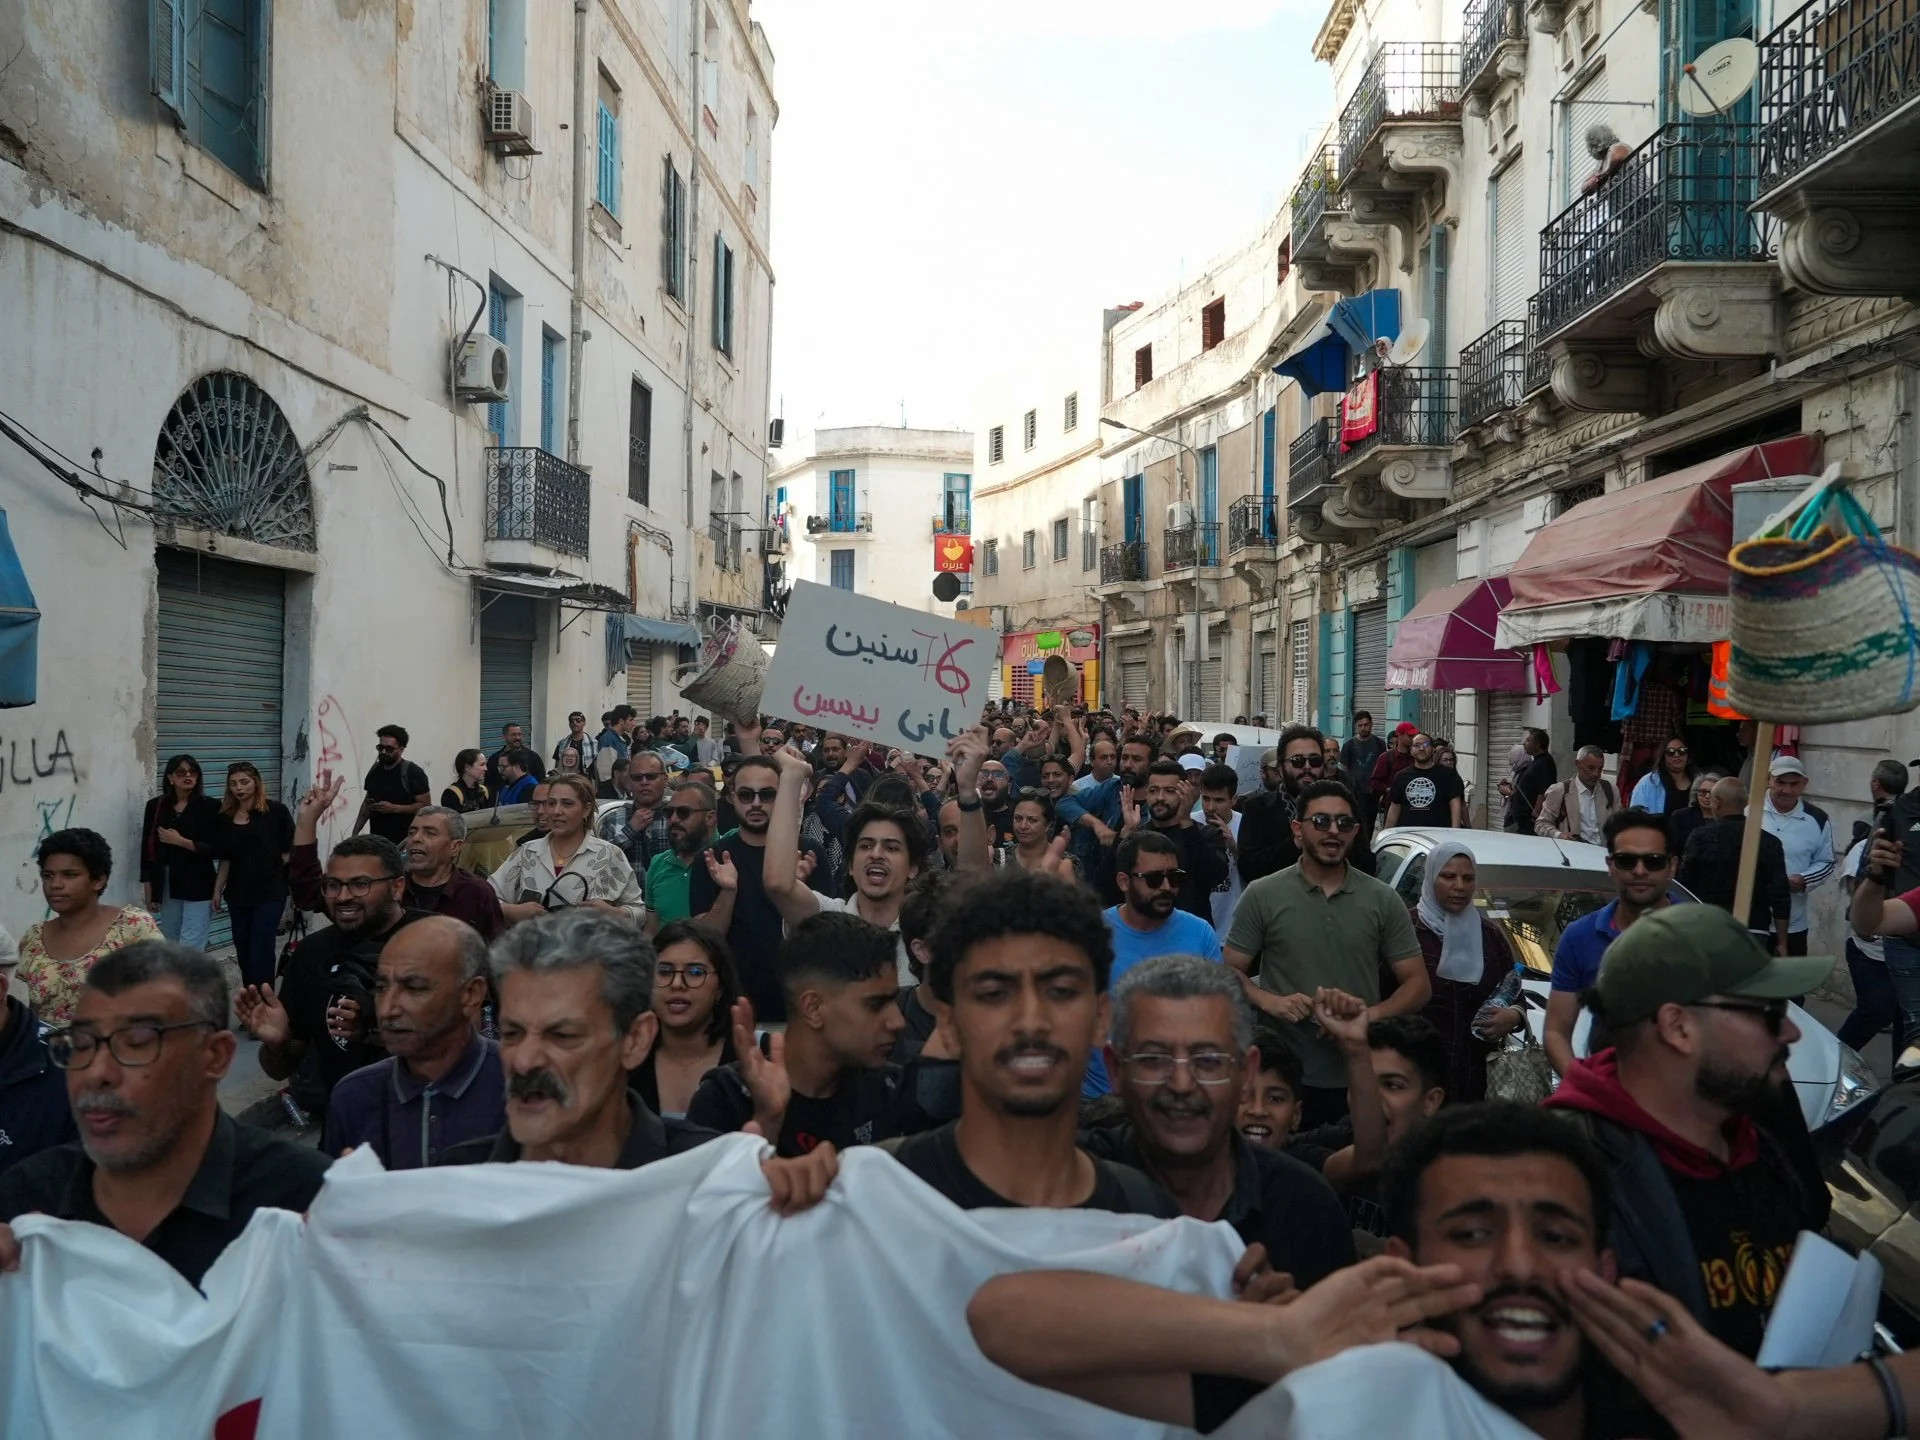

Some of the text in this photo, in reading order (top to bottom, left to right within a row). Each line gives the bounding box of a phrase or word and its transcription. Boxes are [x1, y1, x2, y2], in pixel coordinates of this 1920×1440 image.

[1707, 60, 1732, 76] CAMEX
[942, 560, 965, 571] عزيزة
[826, 623, 918, 665] سنين
[794, 685, 880, 731] بيسين
